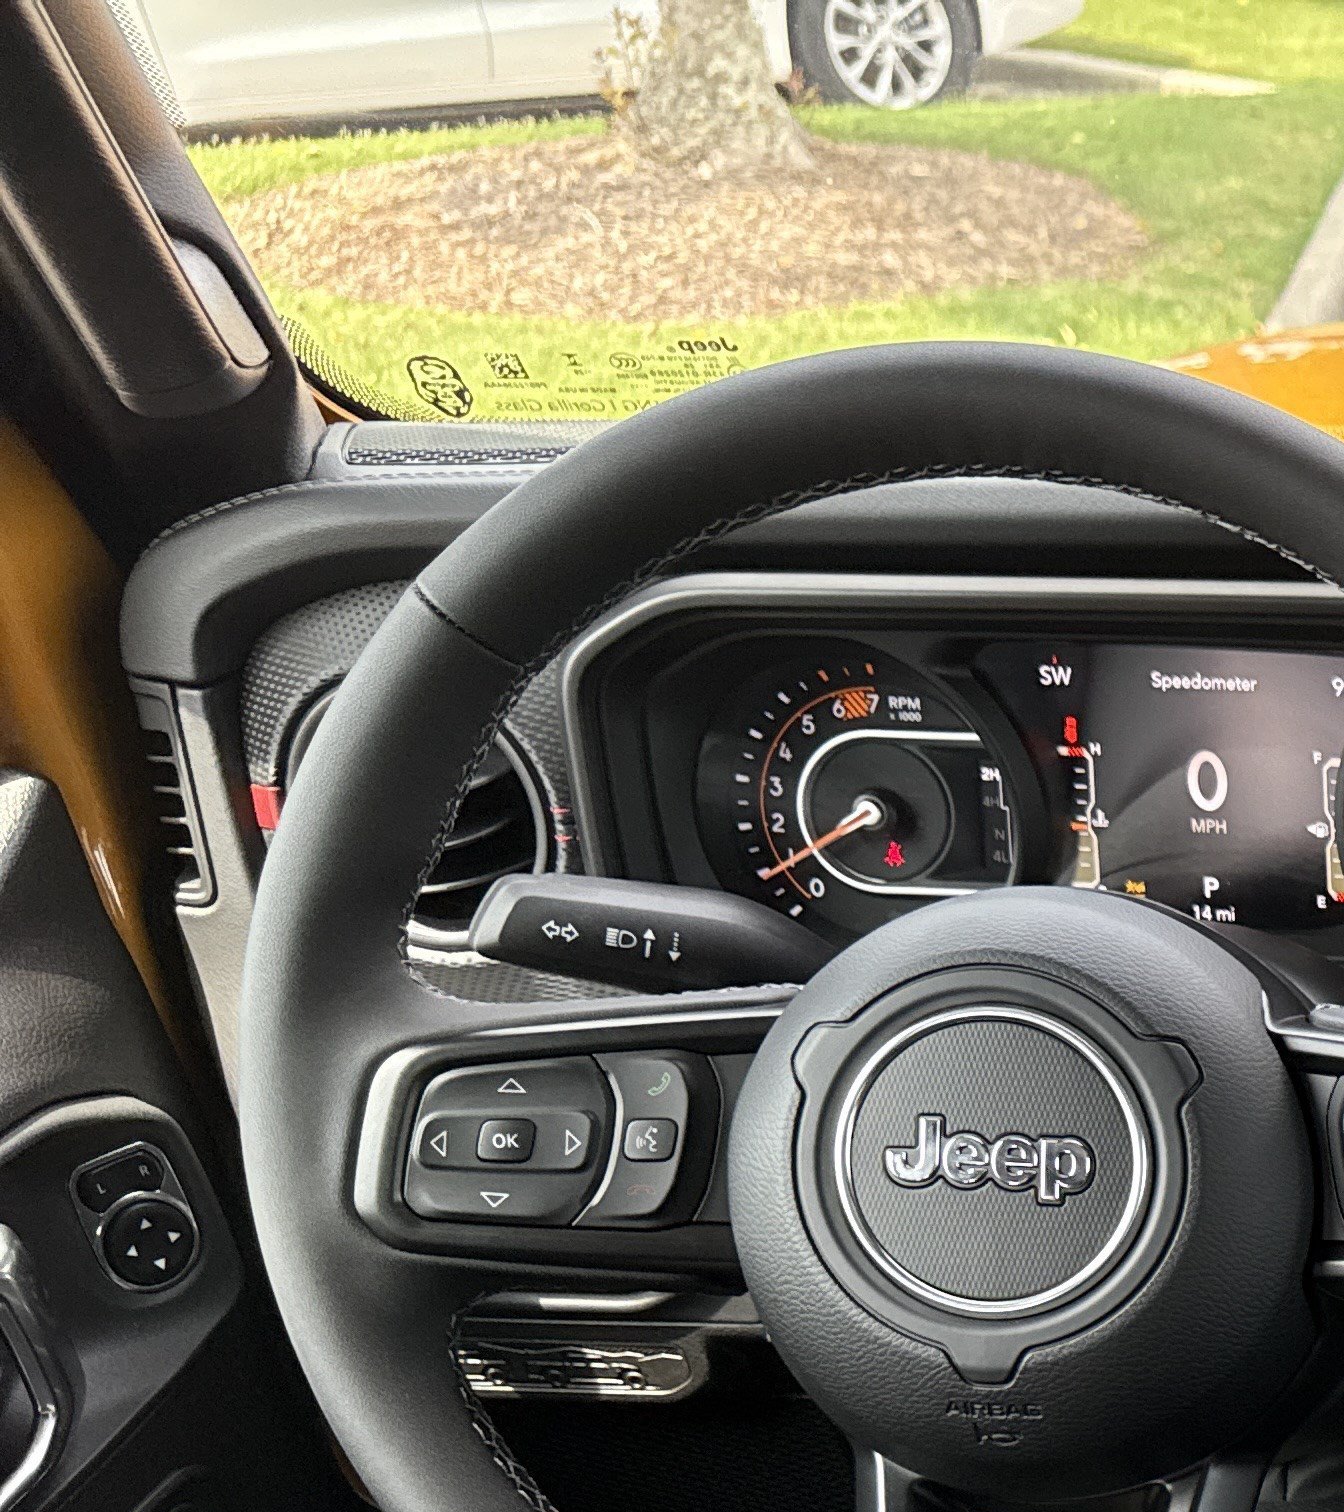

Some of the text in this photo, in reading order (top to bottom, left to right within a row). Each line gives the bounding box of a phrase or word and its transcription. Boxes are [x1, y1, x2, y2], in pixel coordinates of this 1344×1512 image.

[1039, 666, 1072, 687] SW
[1150, 671, 1258, 692] Speedometer
[832, 700, 846, 719] 6
[866, 694, 880, 714] 7
[888, 696, 922, 711] RPM
[801, 714, 816, 735] 5
[898, 712, 922, 723] 1000
[779, 742, 792, 762] 4
[769, 776, 784, 797] 3
[1187, 750, 1228, 811] 0
[771, 813, 785, 834] 2
[1190, 818, 1228, 835] MPH
[809, 877, 826, 899] 0
[1203, 876, 1220, 899] P
[1316, 896, 1327, 909] E
[1192, 904, 1236, 922] 14 mi
[492, 1133, 519, 1149] OK
[885, 1112, 1096, 1206] Jeep
[138, 1164, 151, 1177] R
[96, 1183, 106, 1195] L
